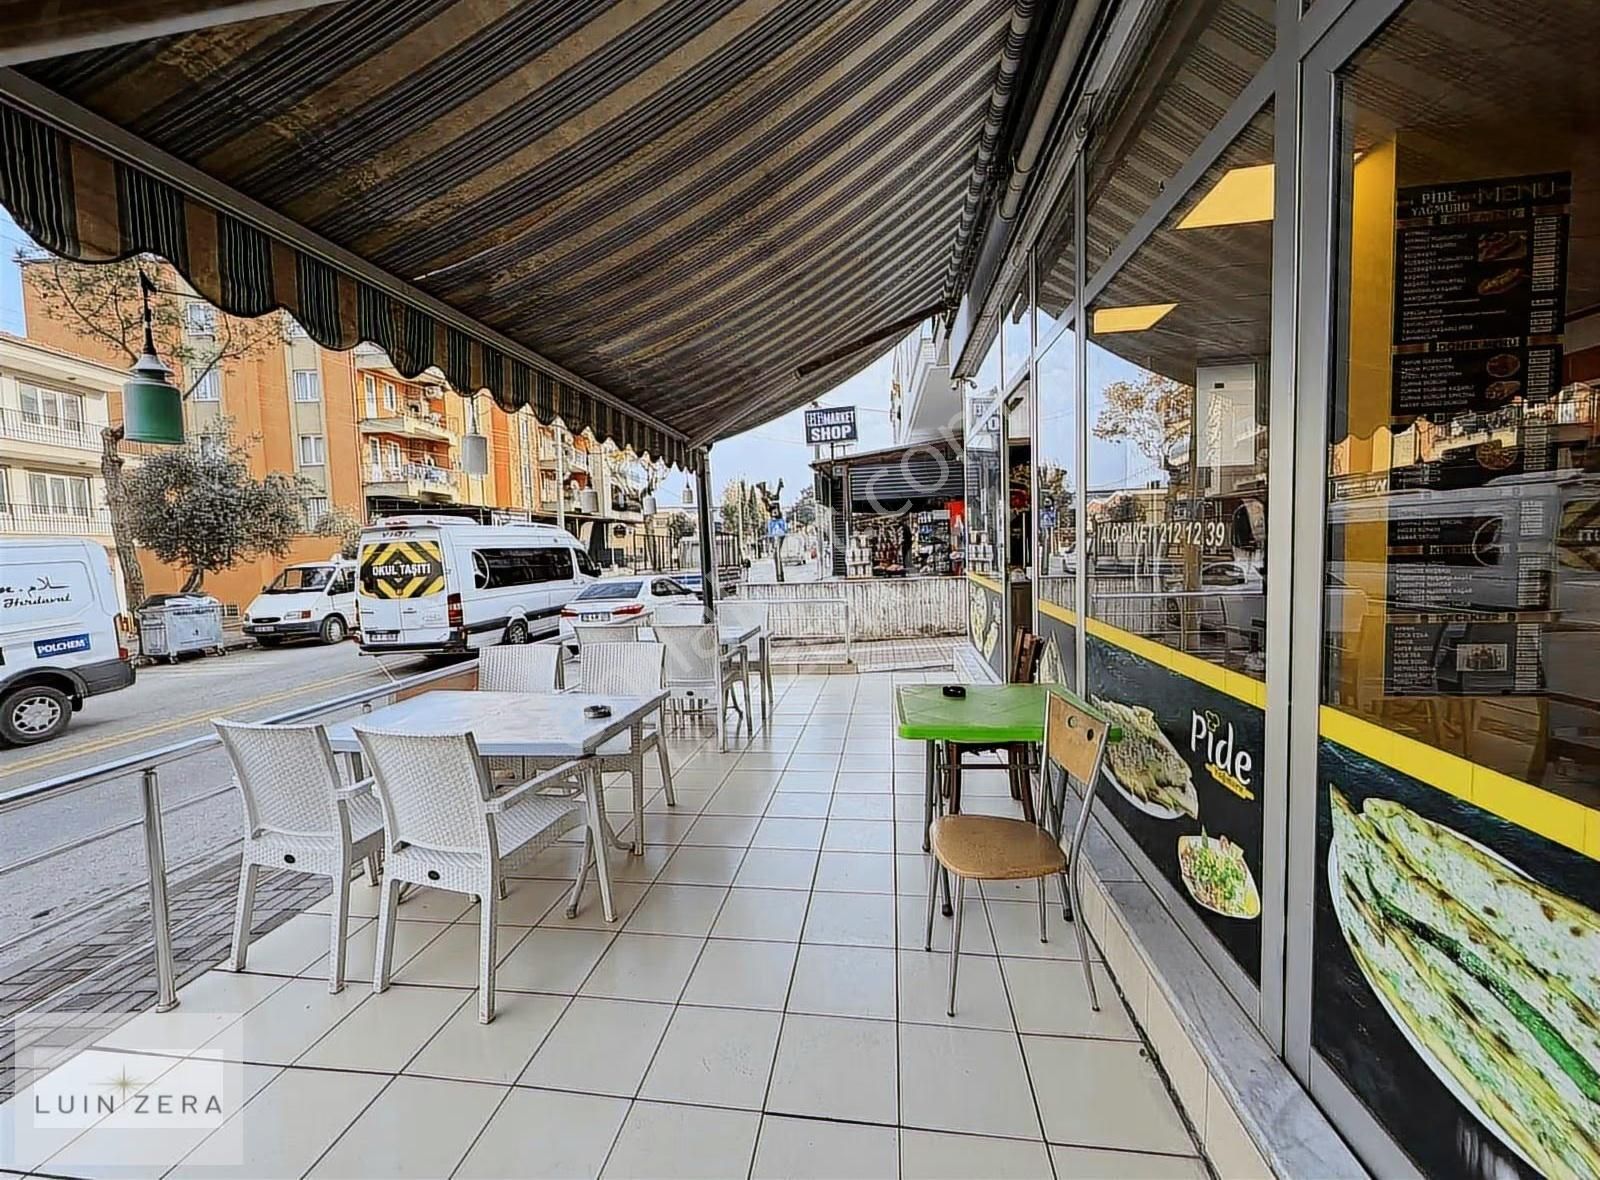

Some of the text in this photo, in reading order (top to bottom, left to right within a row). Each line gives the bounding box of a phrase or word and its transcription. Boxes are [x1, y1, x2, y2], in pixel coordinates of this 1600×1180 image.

[811, 425, 852, 441] SHOP
[1184, 521, 1202, 546] 12
[1205, 522, 1225, 547] 39
[372, 563, 431, 577] OKUL TAŞITI
[37, 639, 86, 655] POLCHEM
[1190, 708, 1252, 785] Pide
